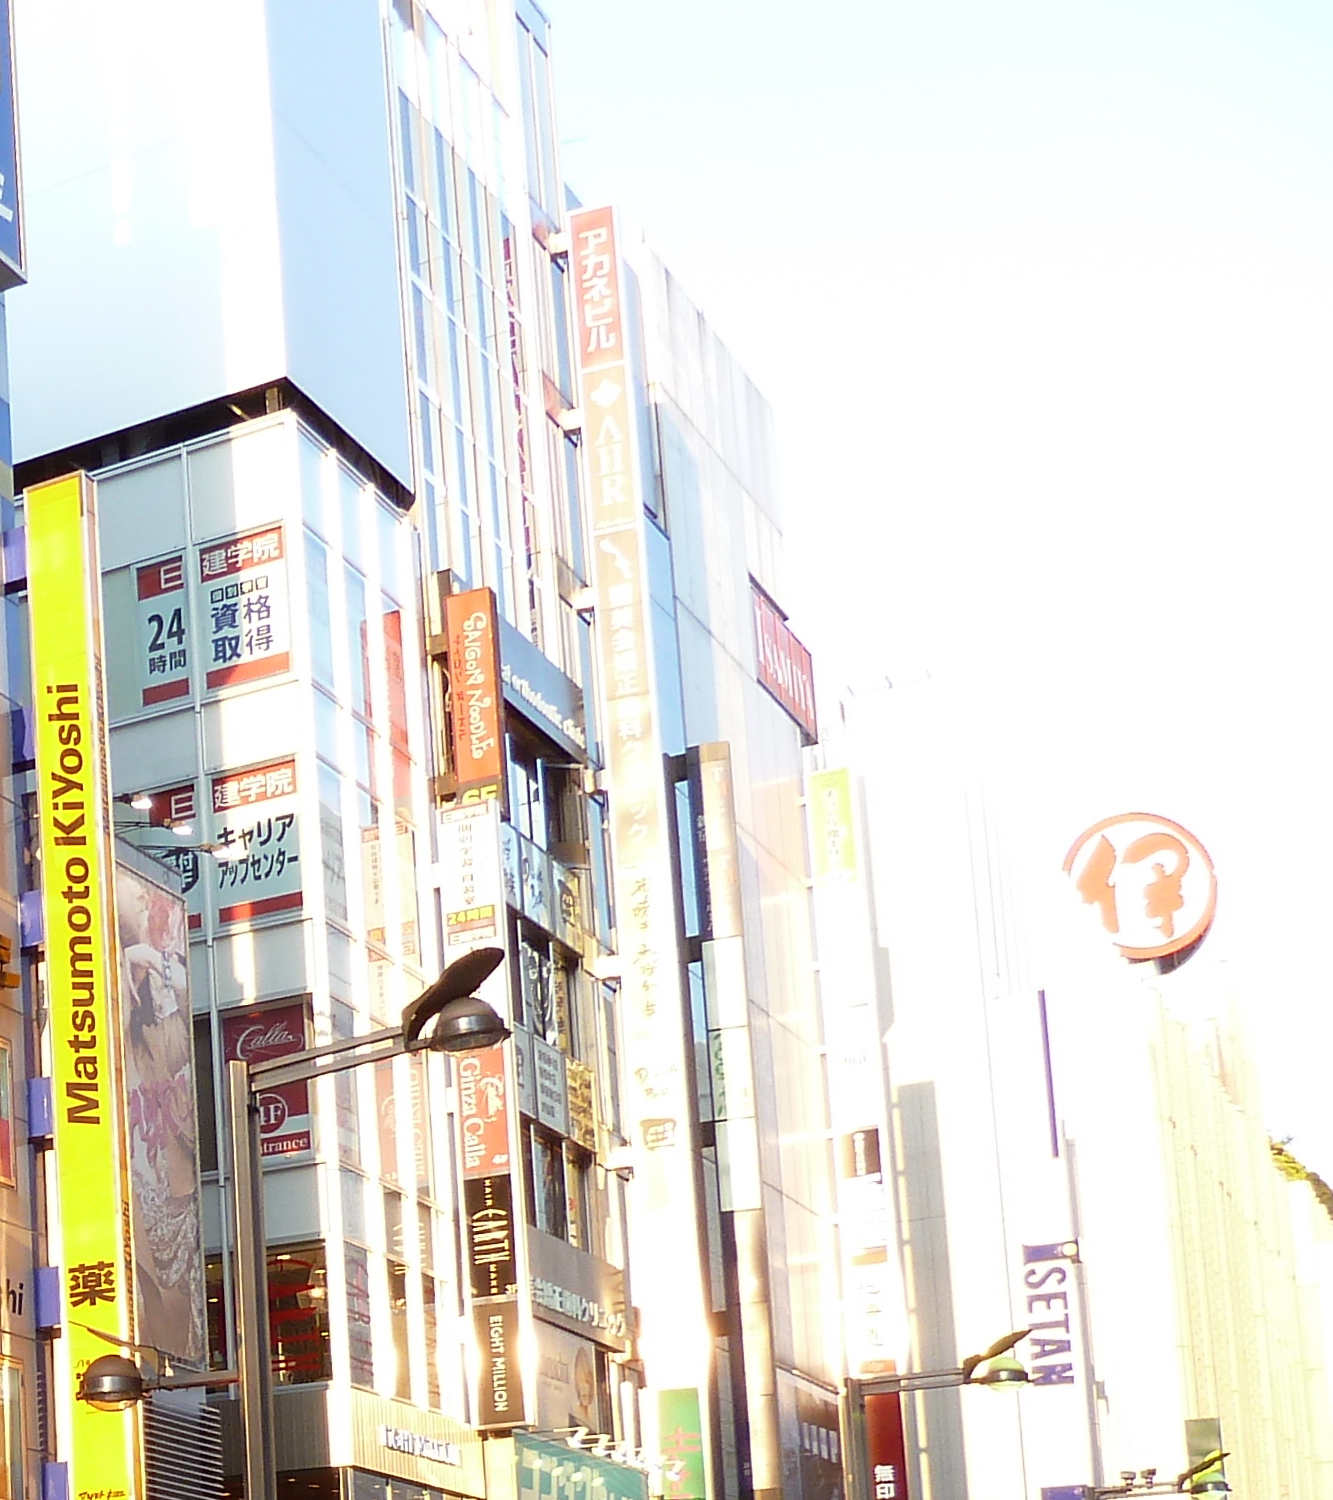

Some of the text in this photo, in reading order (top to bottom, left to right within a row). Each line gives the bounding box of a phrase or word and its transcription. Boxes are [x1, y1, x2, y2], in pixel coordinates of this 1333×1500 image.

[578, 227, 617, 352] アカネビル
[147, 607, 186, 653] 24
[210, 595, 272, 634] 資格
[148, 653, 187, 674] 時間
[211, 628, 274, 664] 取得
[462, 612, 488, 686] SAIGON
[217, 854, 299, 890] アップセンター
[45, 683, 101, 1126] Matsumoto KiYoshi
[460, 1060, 487, 1170] Ginza Calla
[68, 1260, 117, 1309] 薬
[488, 1315, 508, 1412] EIGHT MILLION
[78, 1490, 126, 1500] マツモトキヨシ
